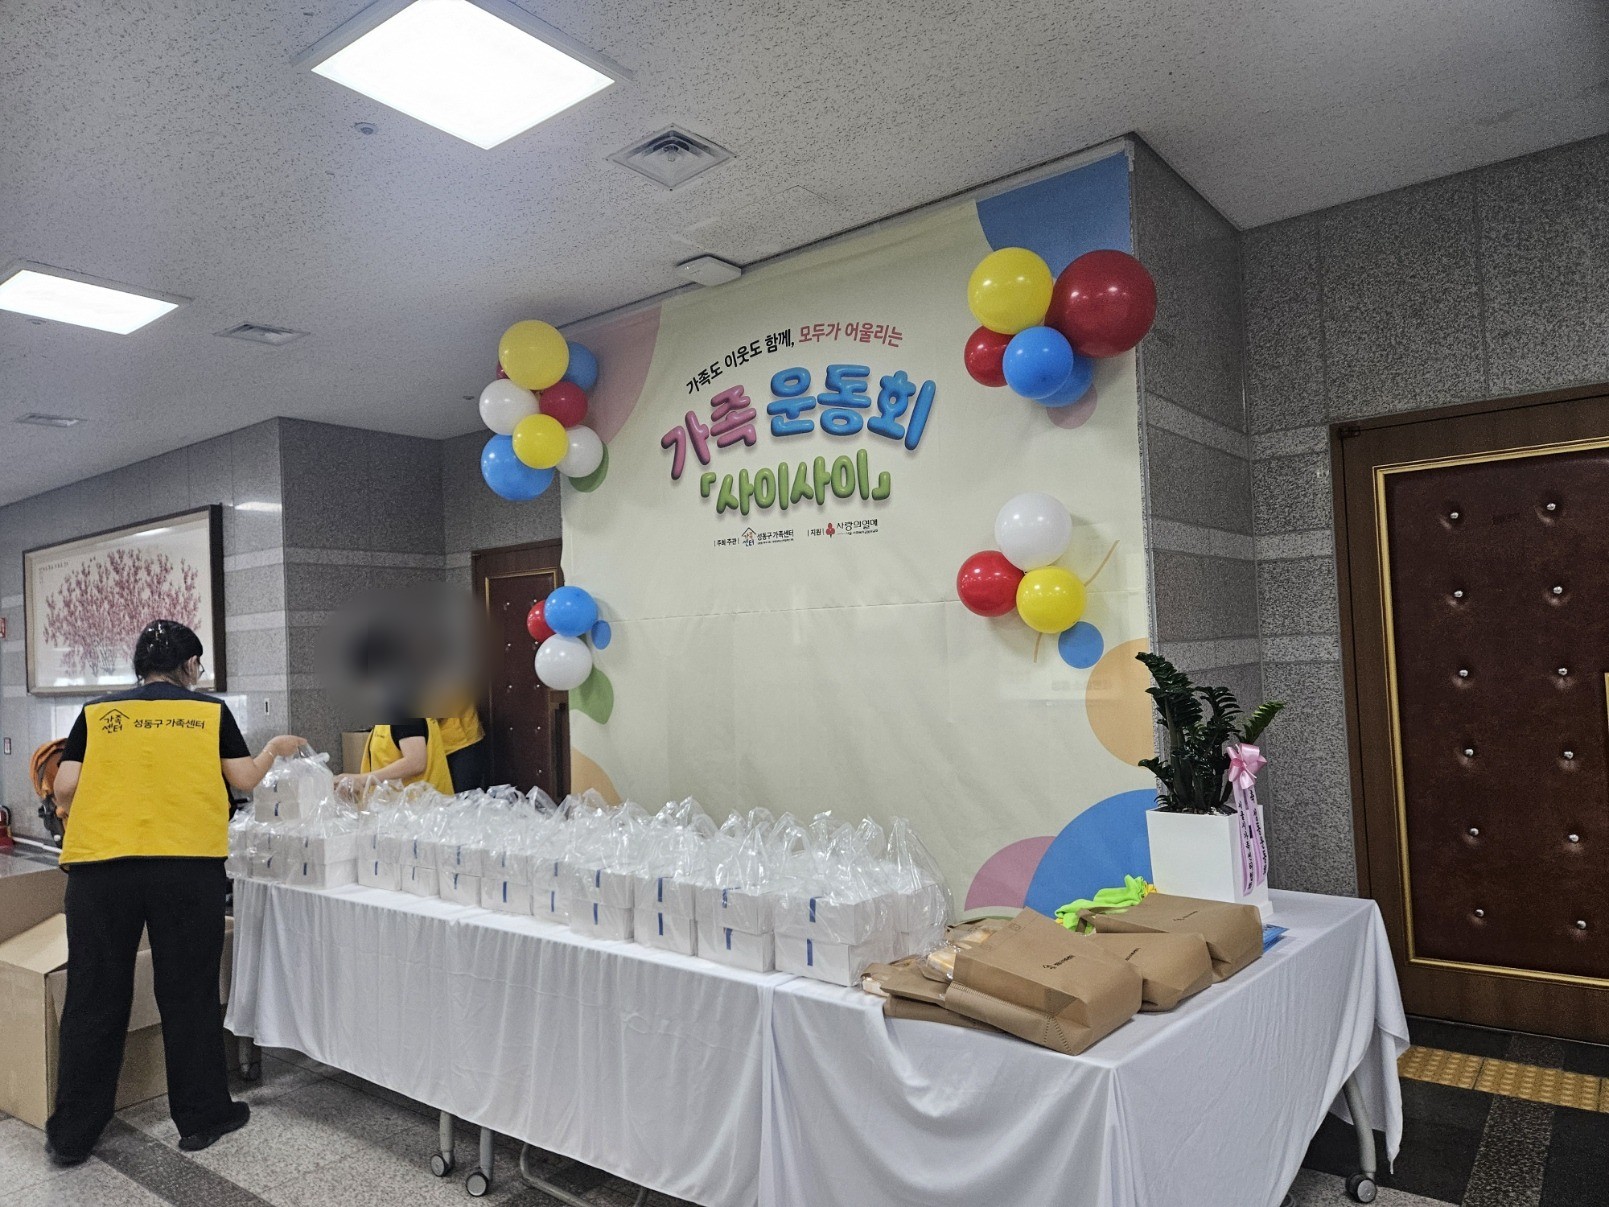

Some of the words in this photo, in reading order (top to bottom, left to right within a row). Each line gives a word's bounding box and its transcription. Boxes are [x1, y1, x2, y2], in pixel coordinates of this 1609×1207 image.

[686, 361, 723, 395] 가족도
[724, 340, 762, 366] 이웃도
[765, 328, 795, 354] 함께,
[799, 322, 841, 343] 모두가
[844, 322, 903, 347] 어울리는
[661, 384, 757, 480] 가족
[767, 364, 937, 451] 운동회
[757, 531, 772, 541] 성동구
[773, 529, 794, 539] 가족센터
[810, 528, 822, 537] 지원
[104, 714, 122, 724] 가족
[133, 718, 163, 729] 성동구
[166, 718, 206, 729] 가족센터
[102, 723, 123, 734] 센터
